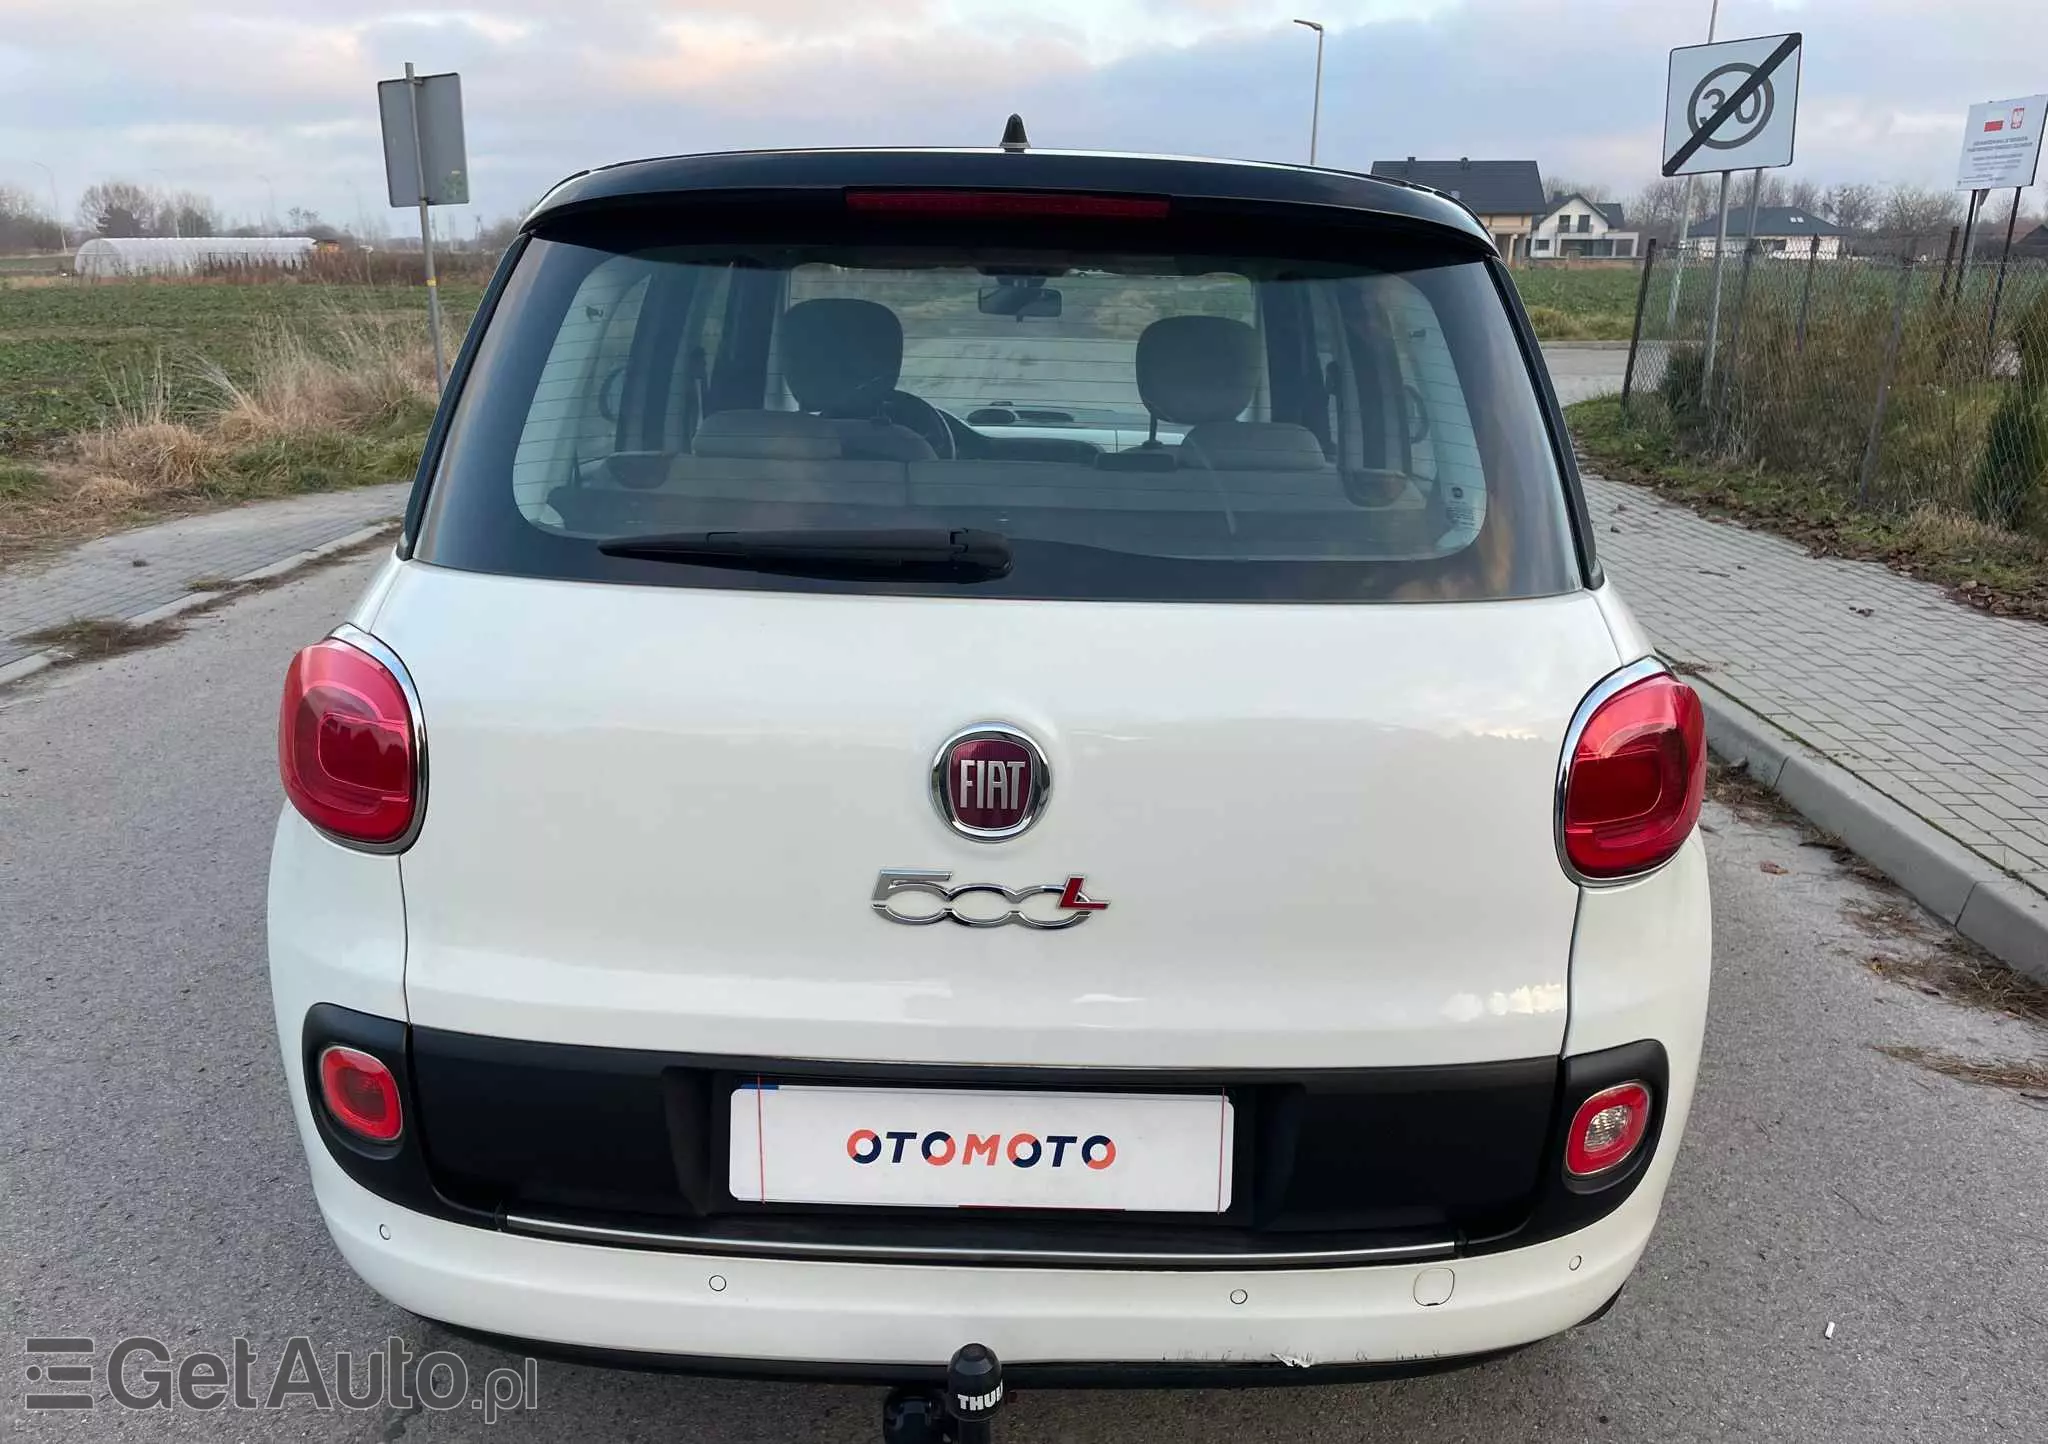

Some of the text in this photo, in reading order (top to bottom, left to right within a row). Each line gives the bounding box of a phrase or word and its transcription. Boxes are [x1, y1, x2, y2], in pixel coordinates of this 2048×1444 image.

[1699, 84, 1762, 127] 30
[959, 759, 1026, 810] FIAT
[870, 867, 1112, 931] 500L
